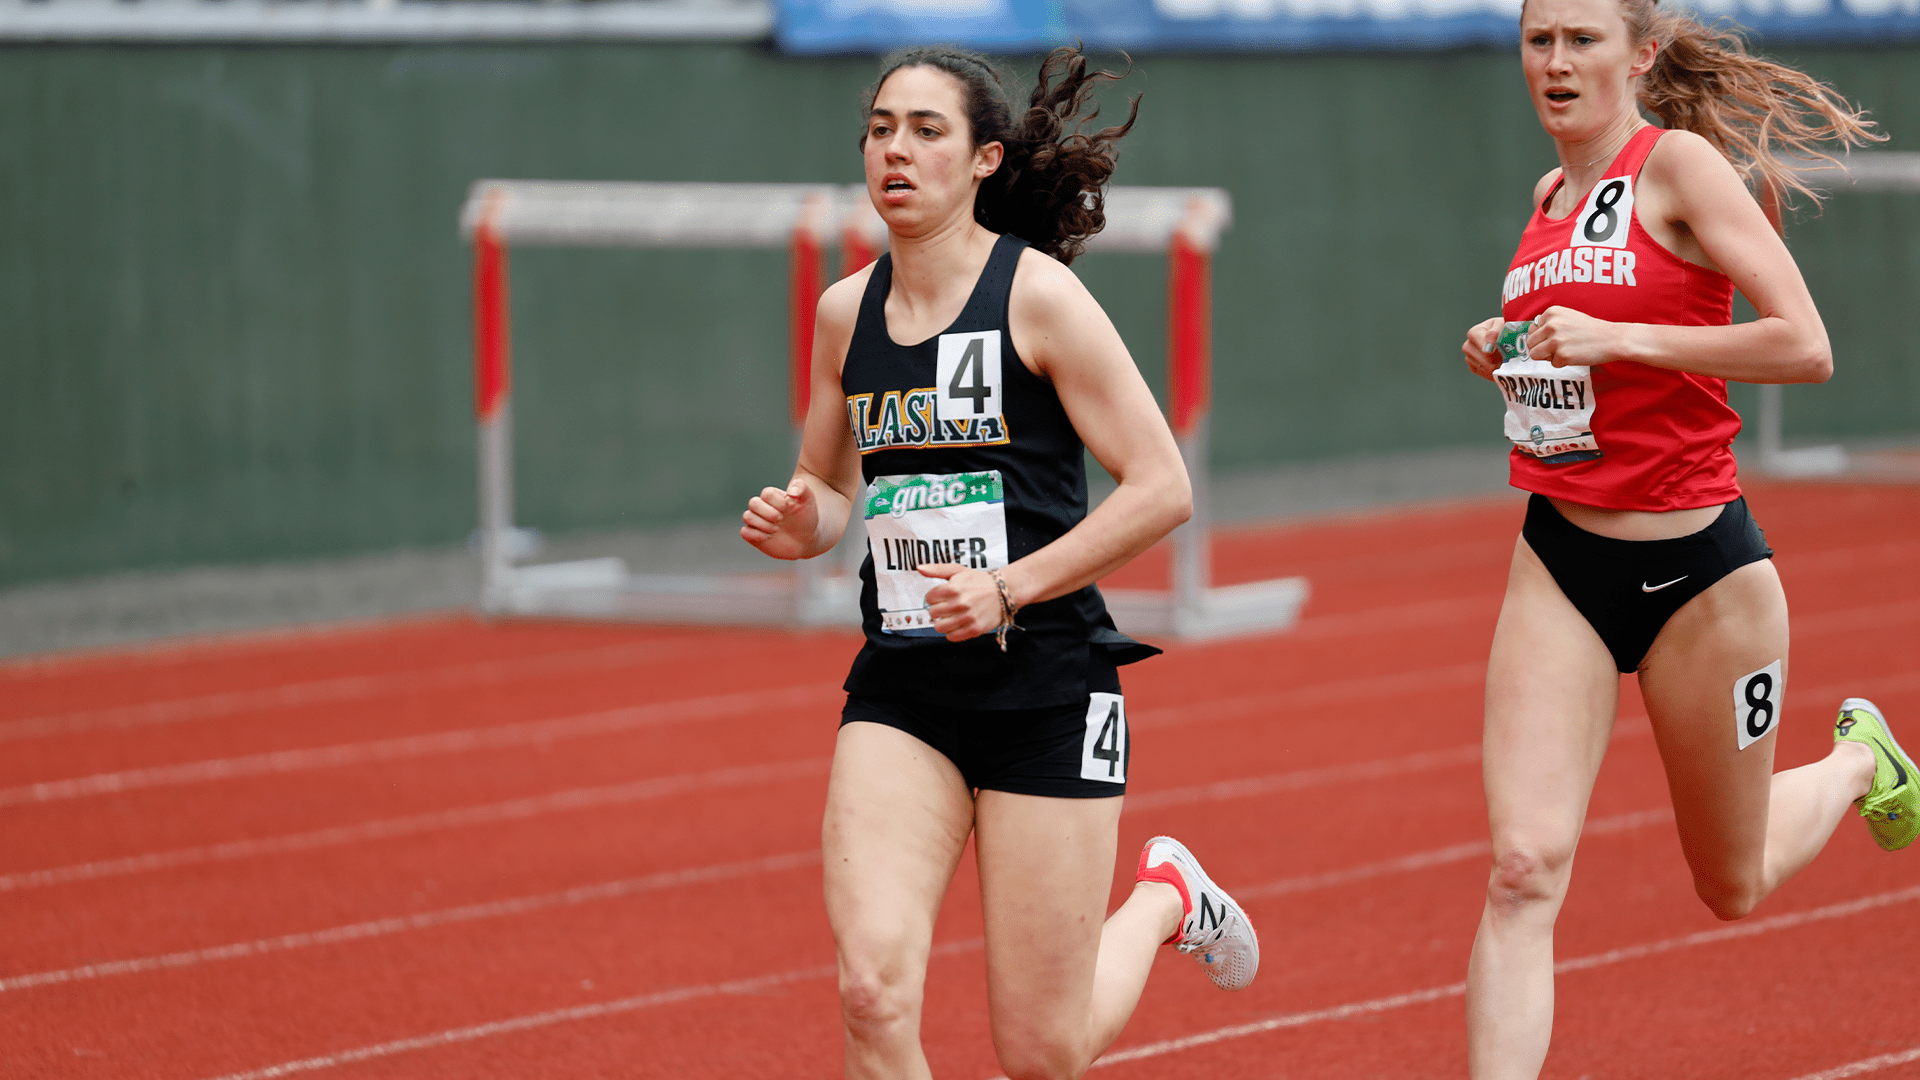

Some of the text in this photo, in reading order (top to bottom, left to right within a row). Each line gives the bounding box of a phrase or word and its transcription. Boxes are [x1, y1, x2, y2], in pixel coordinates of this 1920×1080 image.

[1583, 180, 1625, 242] 8
[1501, 247, 1637, 309] MON FRASER
[948, 338, 992, 414] 4
[1497, 375, 1585, 410] PRANGLEY
[847, 387, 1010, 455] LASKA
[890, 481, 967, 519] gnac
[883, 537, 988, 571] LINDNER
[1744, 672, 1773, 738] 8
[1092, 700, 1120, 777] 4
